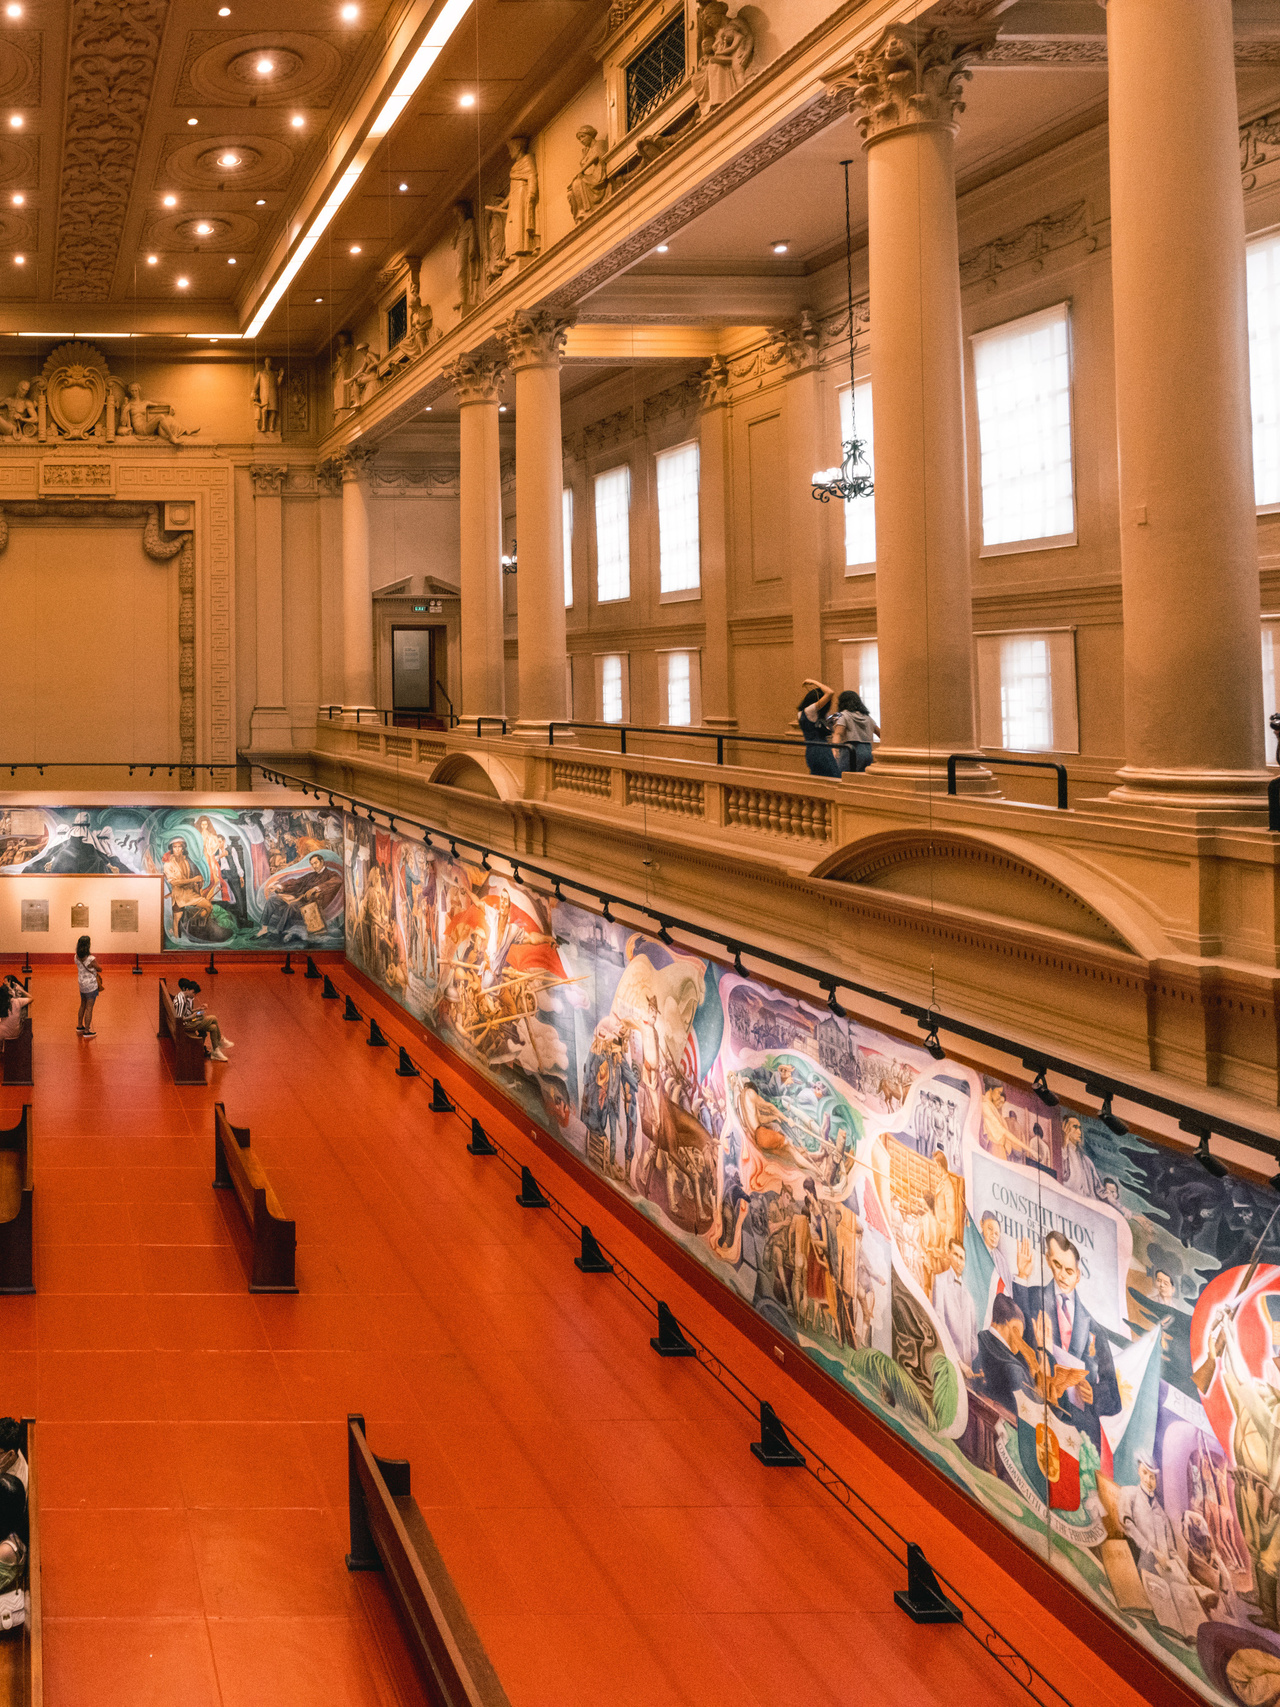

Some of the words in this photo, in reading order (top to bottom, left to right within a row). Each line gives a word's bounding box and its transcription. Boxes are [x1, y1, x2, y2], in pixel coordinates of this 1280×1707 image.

[992, 1182, 1095, 1251] CONSTITUTION
[1027, 1219, 1036, 1229] OF
[997, 1442, 1042, 1512] COMMONWEALTH
